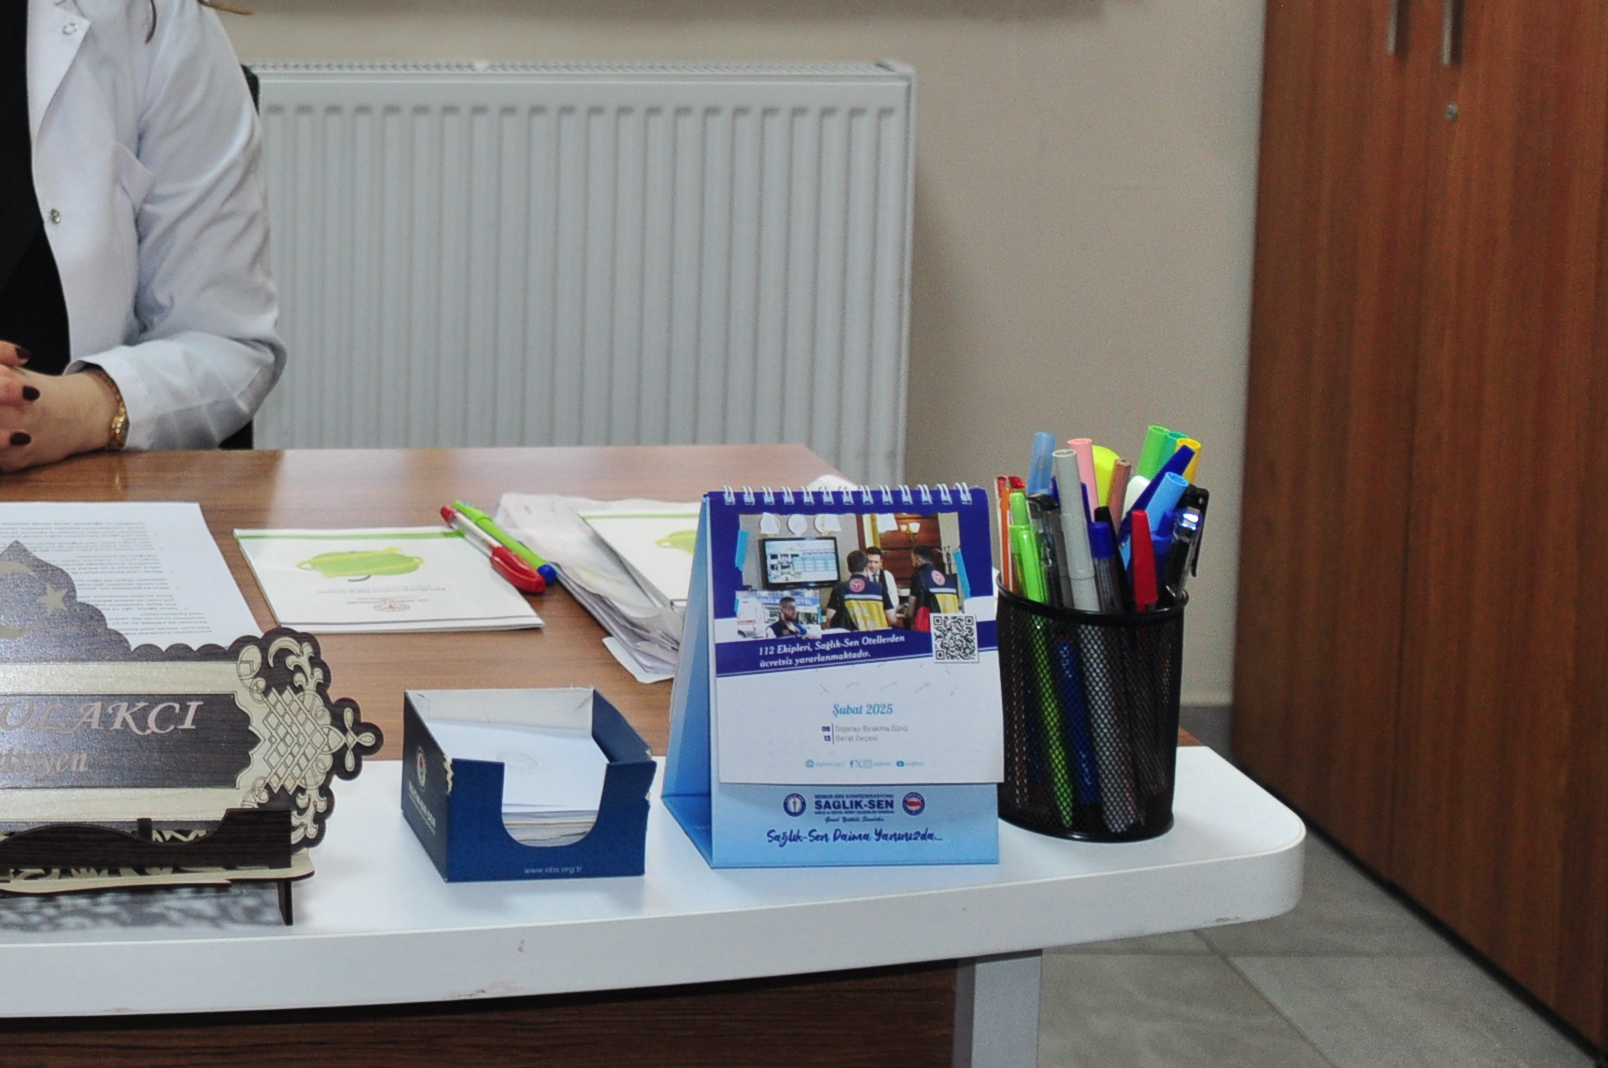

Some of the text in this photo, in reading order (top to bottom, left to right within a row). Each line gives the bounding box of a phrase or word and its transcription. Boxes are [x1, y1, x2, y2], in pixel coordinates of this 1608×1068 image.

[758, 634, 906, 656] 112 Ekipleri, Sağlık-Sen Otellerden
[759, 651, 871, 668] ücretsiz yararlanmaktadır.
[832, 704, 894, 717] Şubat 2025
[766, 828, 829, 848] Sağlık-Sen
[832, 828, 871, 843] Daima
